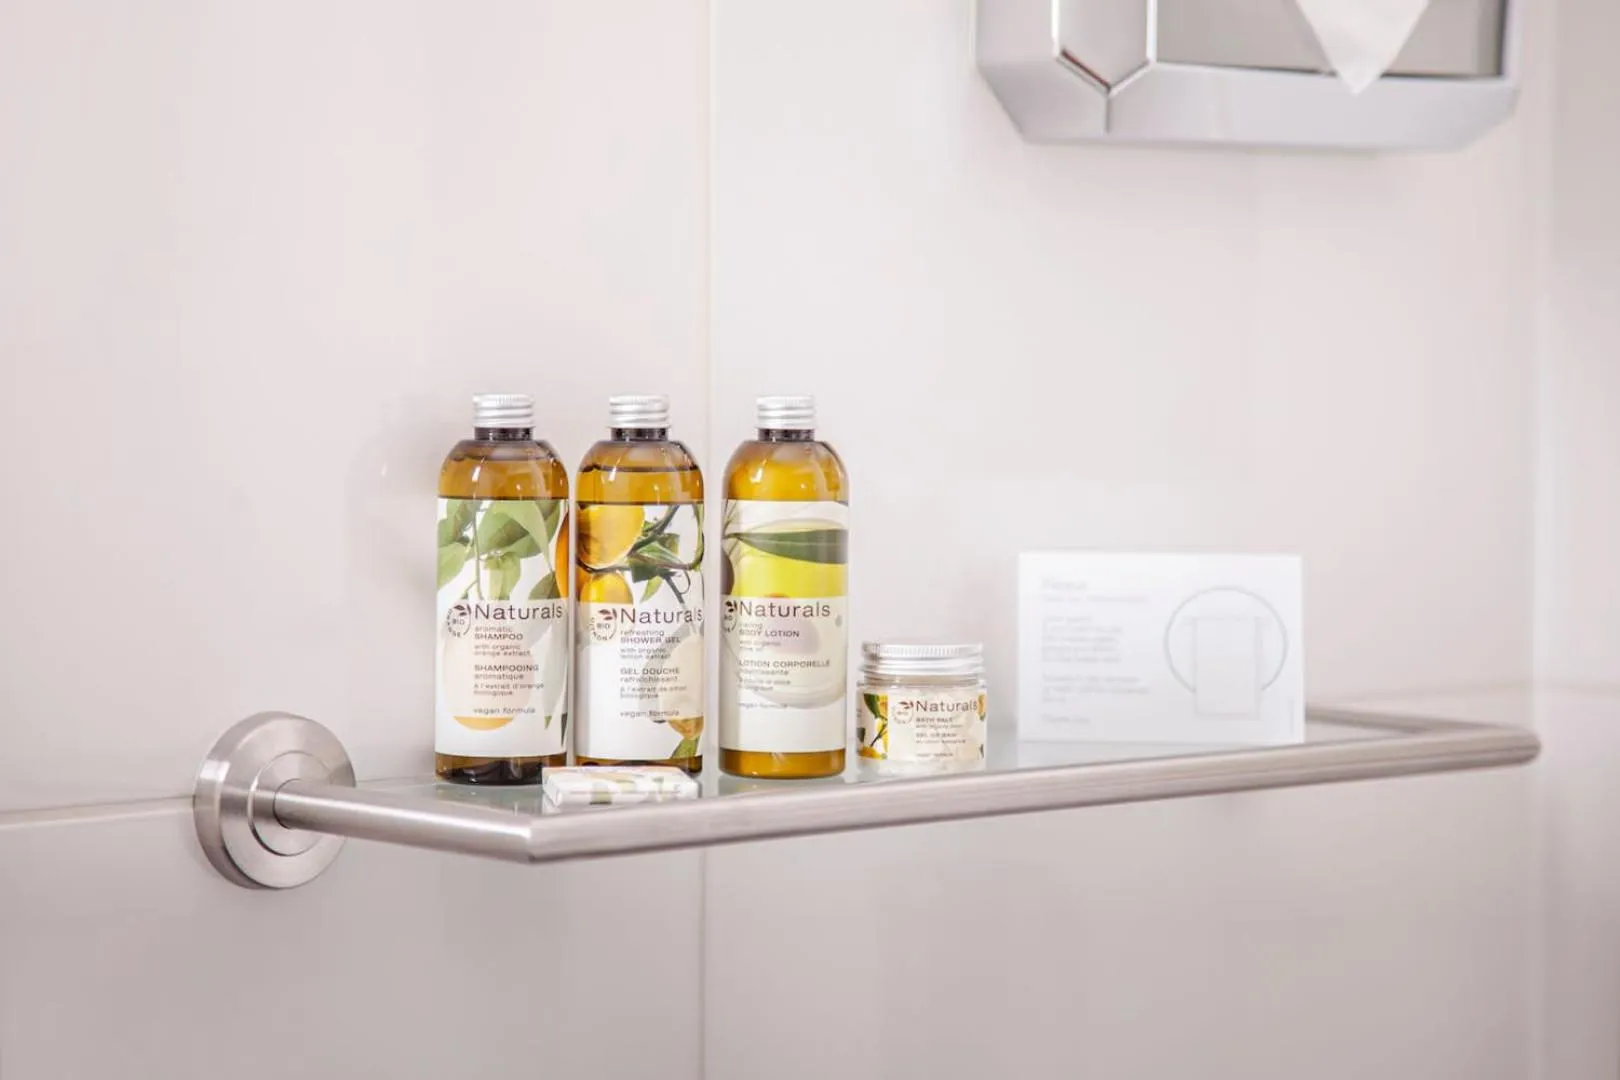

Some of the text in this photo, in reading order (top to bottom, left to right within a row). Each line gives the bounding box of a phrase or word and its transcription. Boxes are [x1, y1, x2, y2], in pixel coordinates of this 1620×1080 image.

[474, 603, 563, 620] Naturals
[739, 600, 831, 618] Naturals
[620, 607, 703, 624] Naturals
[474, 625, 513, 633] aromatic
[620, 629, 665, 637] refreshing
[620, 636, 662, 644] SHOWER
[739, 659, 831, 668] LOTION CORPORELLE
[474, 664, 539, 672] SHAMPOOING
[620, 667, 680, 675] GEL DOUCHE
[474, 673, 524, 681] aromatique
[916, 700, 978, 713] Naturals
[473, 707, 500, 715] vegan
[648, 710, 680, 718] formula
